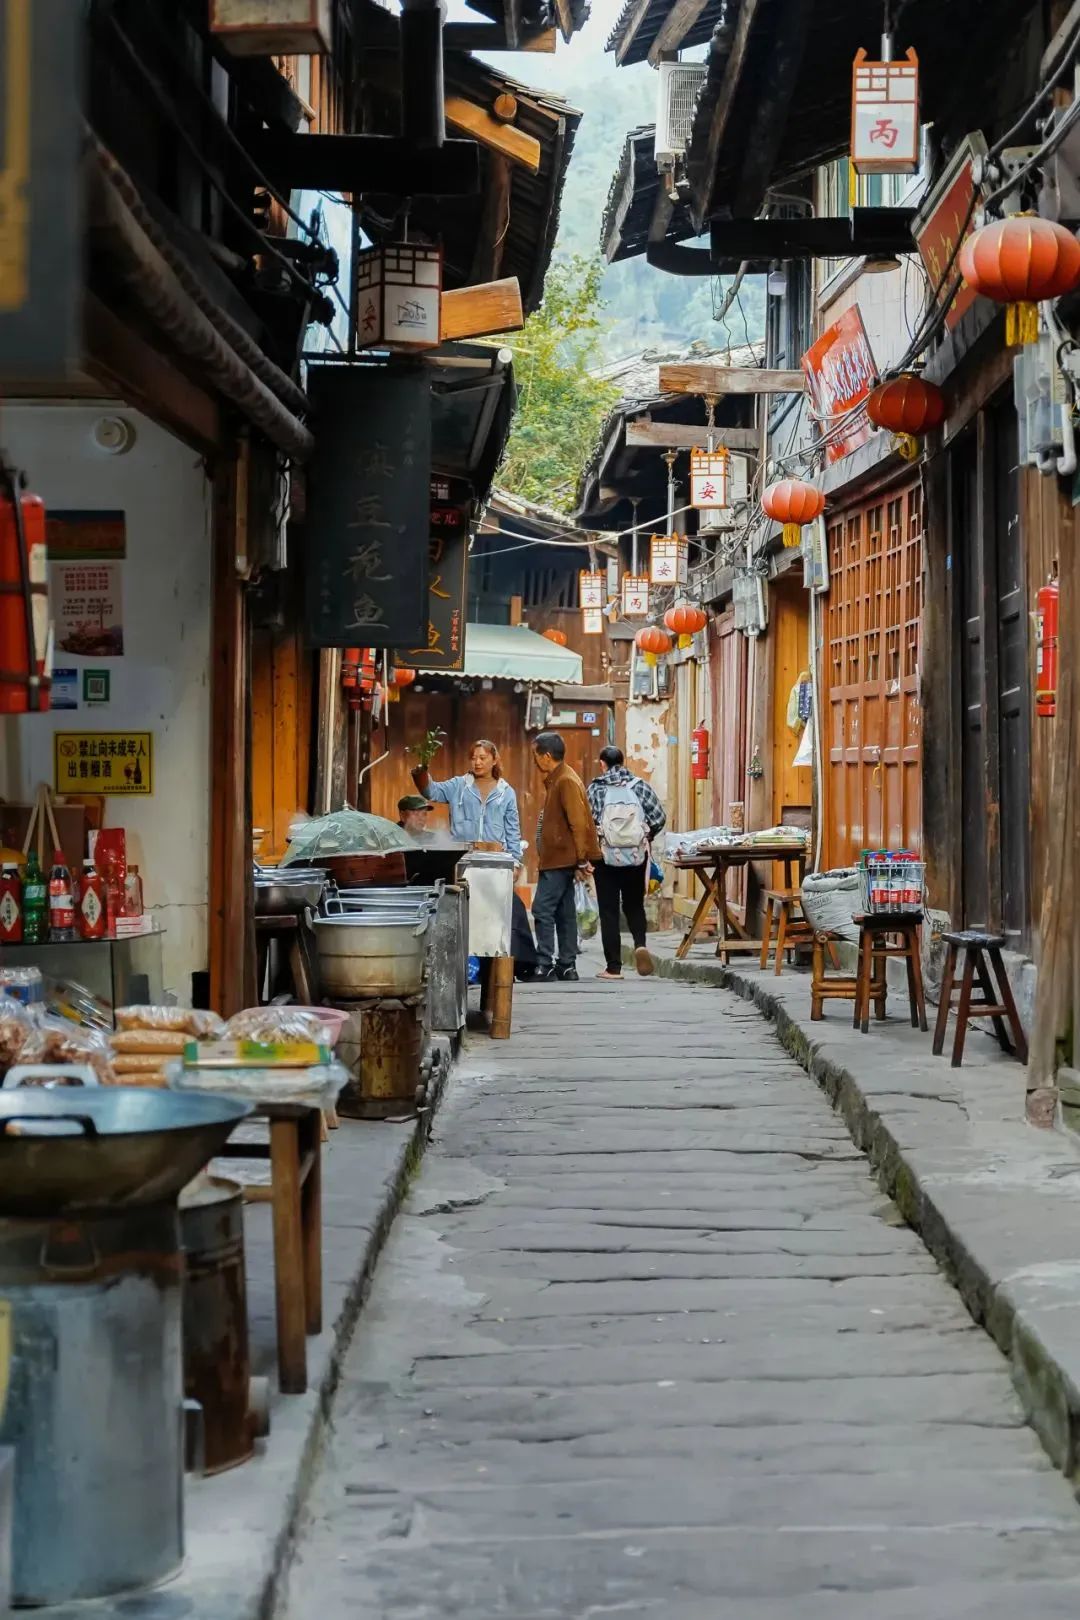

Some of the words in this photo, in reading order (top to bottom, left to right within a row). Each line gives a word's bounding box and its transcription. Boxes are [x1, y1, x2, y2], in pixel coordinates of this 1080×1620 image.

[869, 118, 899, 150] 丙
[698, 481, 717, 500] 安
[657, 561, 672, 577] 安
[630, 598, 642, 609] 丙
[79, 739, 146, 757] 禁止向未成年人
[67, 760, 112, 778] 出售烟酒
